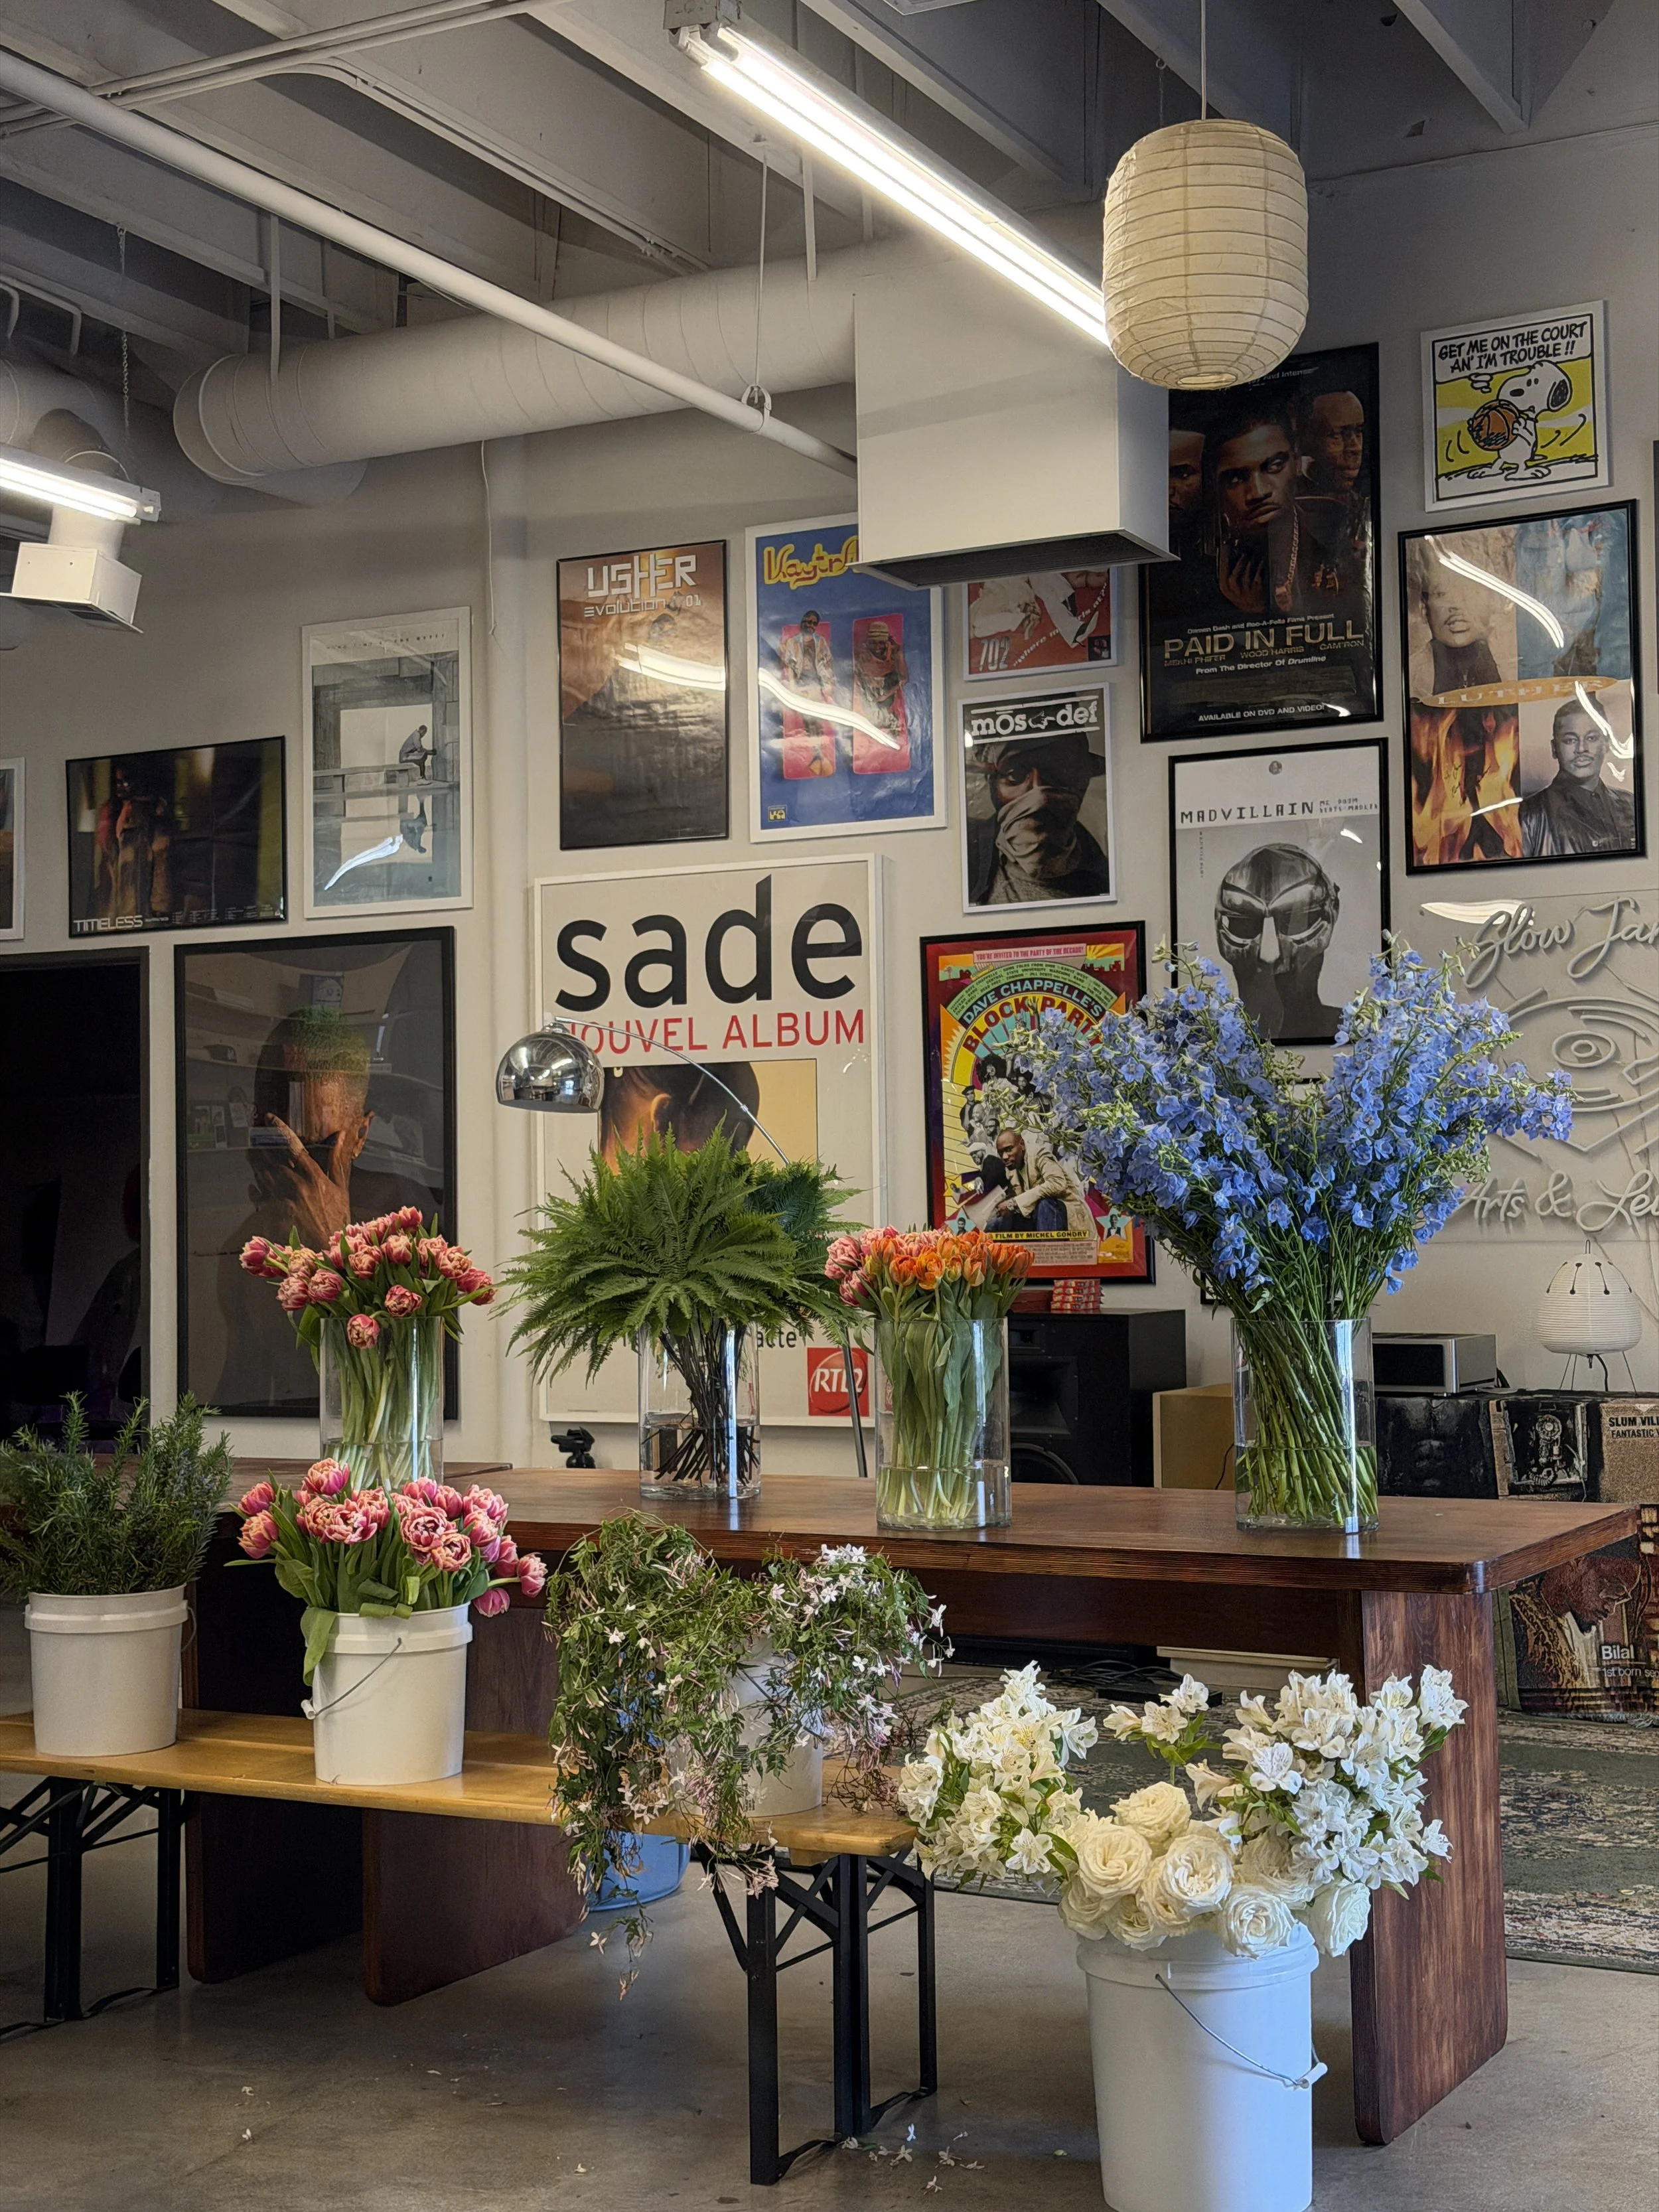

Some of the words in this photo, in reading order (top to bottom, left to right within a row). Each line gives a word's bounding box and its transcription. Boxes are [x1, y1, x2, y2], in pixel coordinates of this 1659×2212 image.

[1438, 342, 1465, 360] GET
[1467, 338, 1488, 355] ME
[1490, 334, 1511, 352] ON
[1512, 329, 1539, 347] THE
[1541, 321, 1587, 342] COURT
[1450, 353, 1474, 373] AN'
[1476, 351, 1498, 370] I'M
[1500, 342, 1561, 366] TROUBLE
[587, 553, 697, 598] USHER
[1164, 633, 1235, 659] PAID
[1245, 628, 1274, 650] IN
[1286, 620, 1364, 646] FULL
[1240, 649, 1268, 659] WOOD
[1271, 646, 1305, 656] HARRIS
[979, 636, 1010, 672] 702
[1238, 661, 1273, 671] Director
[1287, 656, 1327, 666] Drumline
[1056, 701, 1098, 726] def
[1198, 711, 1241, 722] AVAILABLE
[1181, 802, 1313, 824] MADVILLAIN
[74, 915, 143, 932] TIMELESS
[555, 873, 863, 1012] sade
[962, 990, 999, 1025] DAVE
[998, 979, 1104, 1019] CHAPPELLE'S
[722, 1009, 864, 1049] ALBUM
[962, 996, 1029, 1053] BLOCK
[1453, 1178, 1526, 1221] Arts
[1535, 1170, 1572, 1217] &
[1609, 1416, 1637, 1427] SLUM
[1611, 1429, 1654, 1439] FANTASTIC
[1601, 1645, 1634, 1659] Bilal
[1602, 1666, 1616, 1677] 1st
[1619, 1666, 1642, 1676] born
